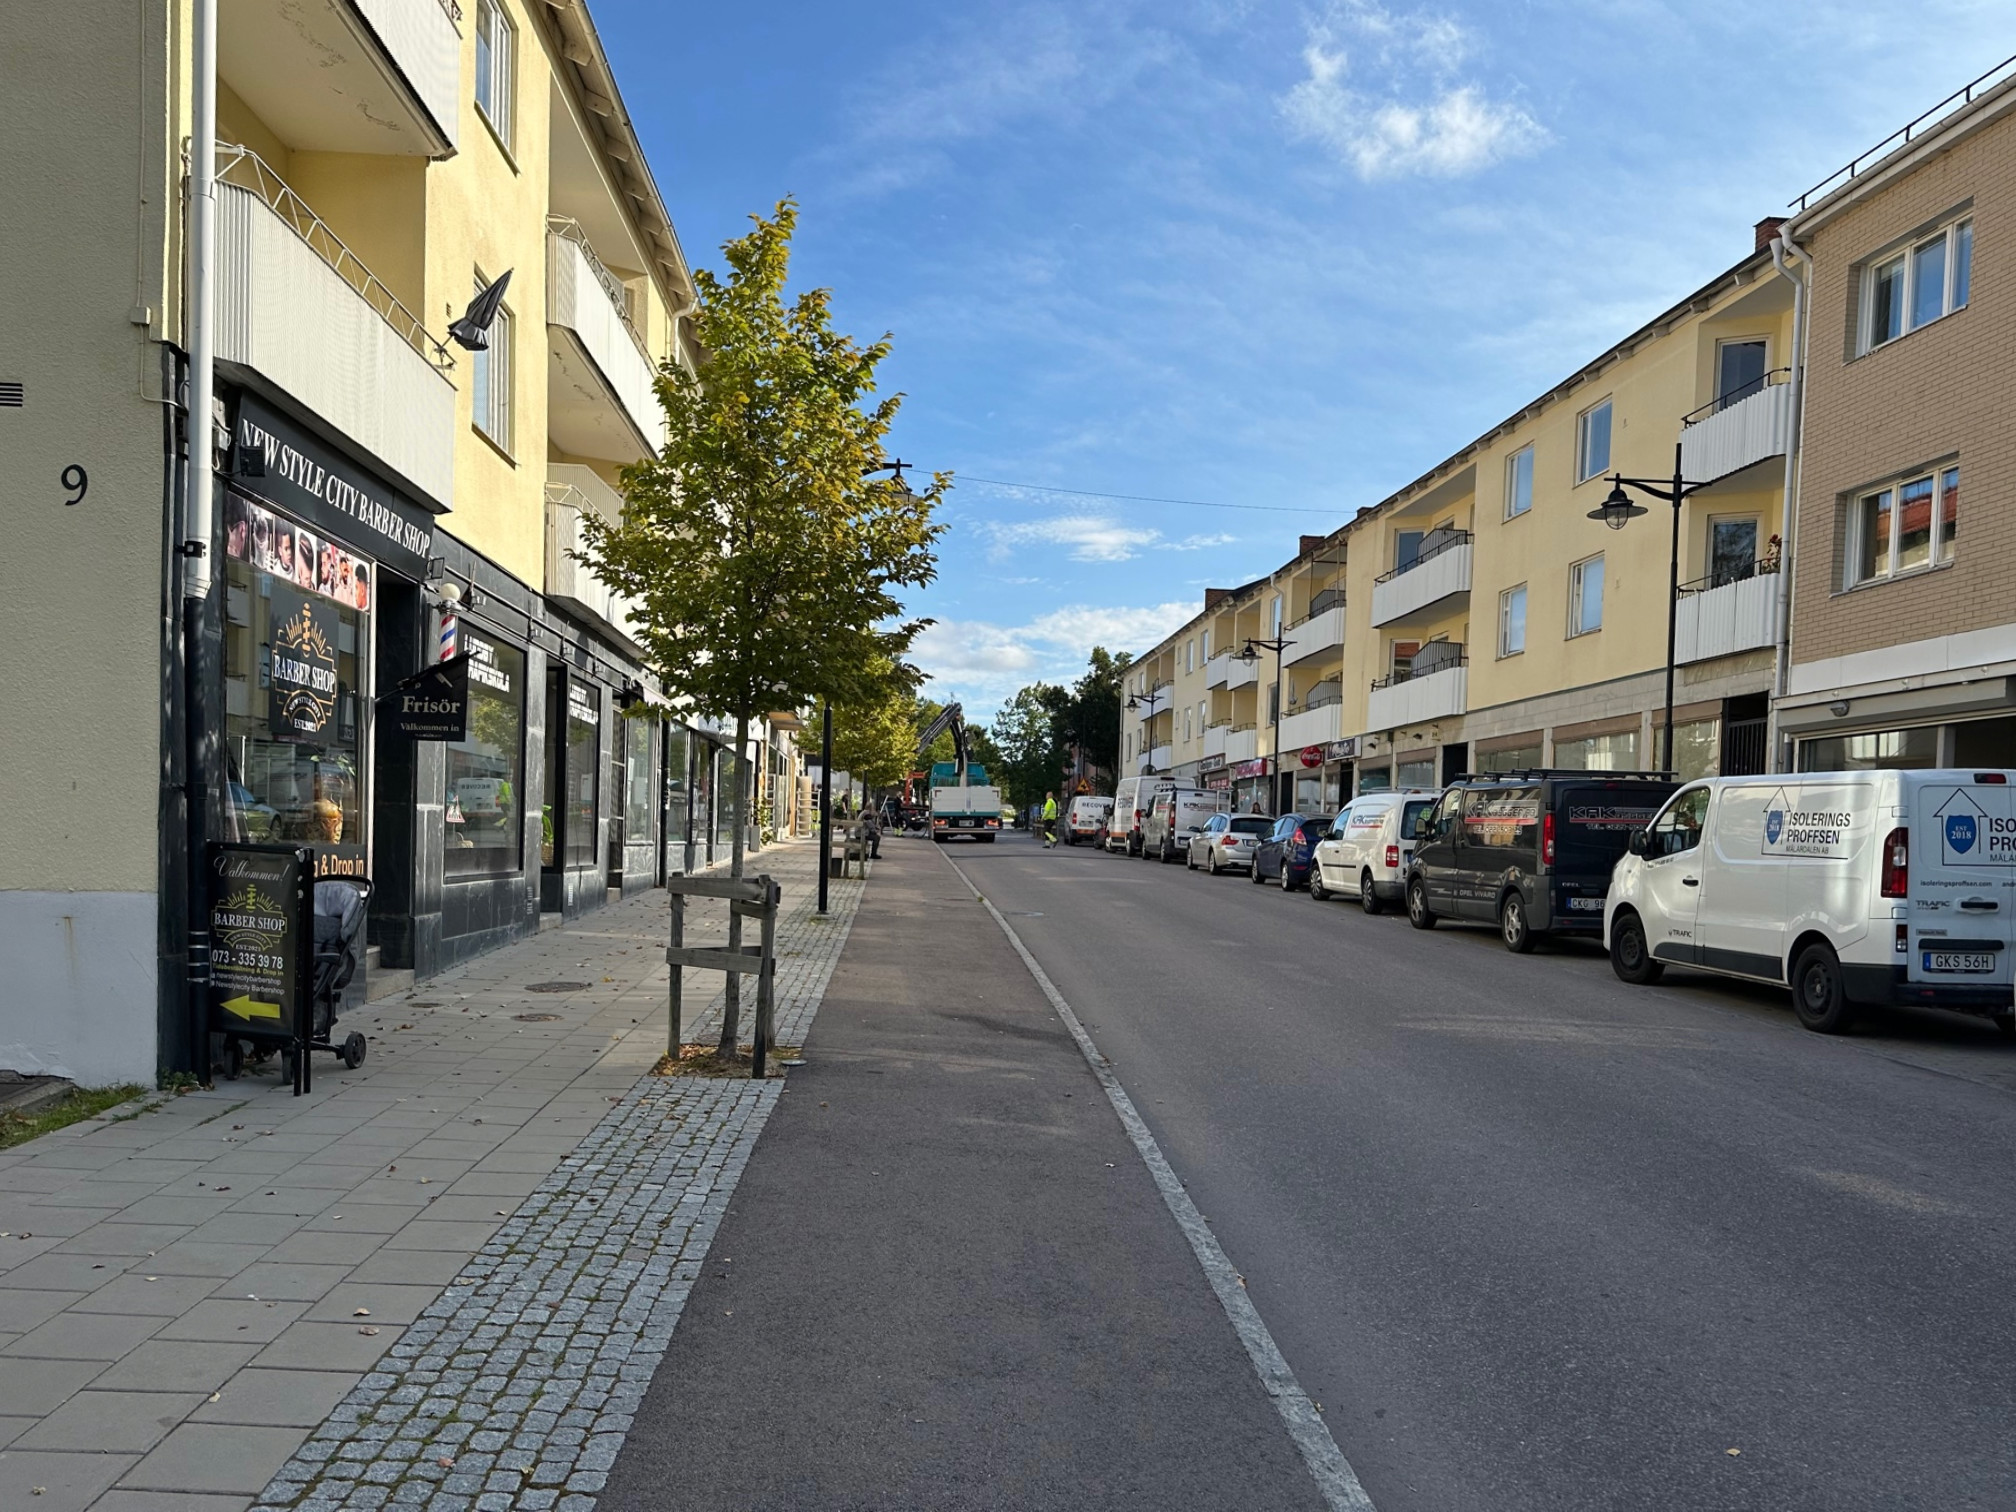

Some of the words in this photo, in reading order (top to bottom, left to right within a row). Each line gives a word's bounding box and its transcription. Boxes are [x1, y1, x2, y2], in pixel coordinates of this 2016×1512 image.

[61, 464, 88, 506] 9
[241, 418, 280, 469] NEW
[279, 444, 325, 498] STYLE
[326, 474, 360, 516] CITY
[358, 492, 403, 544] BARBER
[402, 521, 431, 559] SHOP
[274, 655, 311, 686] BARBER
[312, 666, 335, 693] SHOP
[402, 695, 461, 714] Frisör
[400, 722, 449, 731] Välkommen
[450, 723, 460, 732] in
[1466, 800, 1494, 817] KAK
[1569, 806, 1616, 819] KAK
[1789, 812, 1851, 827] ISOLERINGS
[1787, 829, 1840, 844] PROFFSEN
[1951, 831, 1971, 839] 2018
[213, 856, 290, 882] Välkommen!
[321, 854, 328, 876] &
[356, 853, 364, 876] in
[1920, 880, 1992, 888] isoleringsproffsen.com
[1475, 889, 1496, 898] VIVARO
[1572, 899, 1589, 908] CKG
[1594, 900, 1606, 909] 96
[214, 912, 255, 928] BARBER
[257, 917, 286, 931] SHOP
[1673, 929, 1692, 938] TRAFIC
[212, 949, 230, 963] 073
[238, 952, 256, 966] 335
[257, 954, 270, 968] 39
[272, 956, 284, 969] 78
[1936, 955, 1960, 968] GKS
[1964, 955, 1989, 968] 56H
[262, 968, 276, 976] Drop
[251, 984, 285, 996] Barbershop
